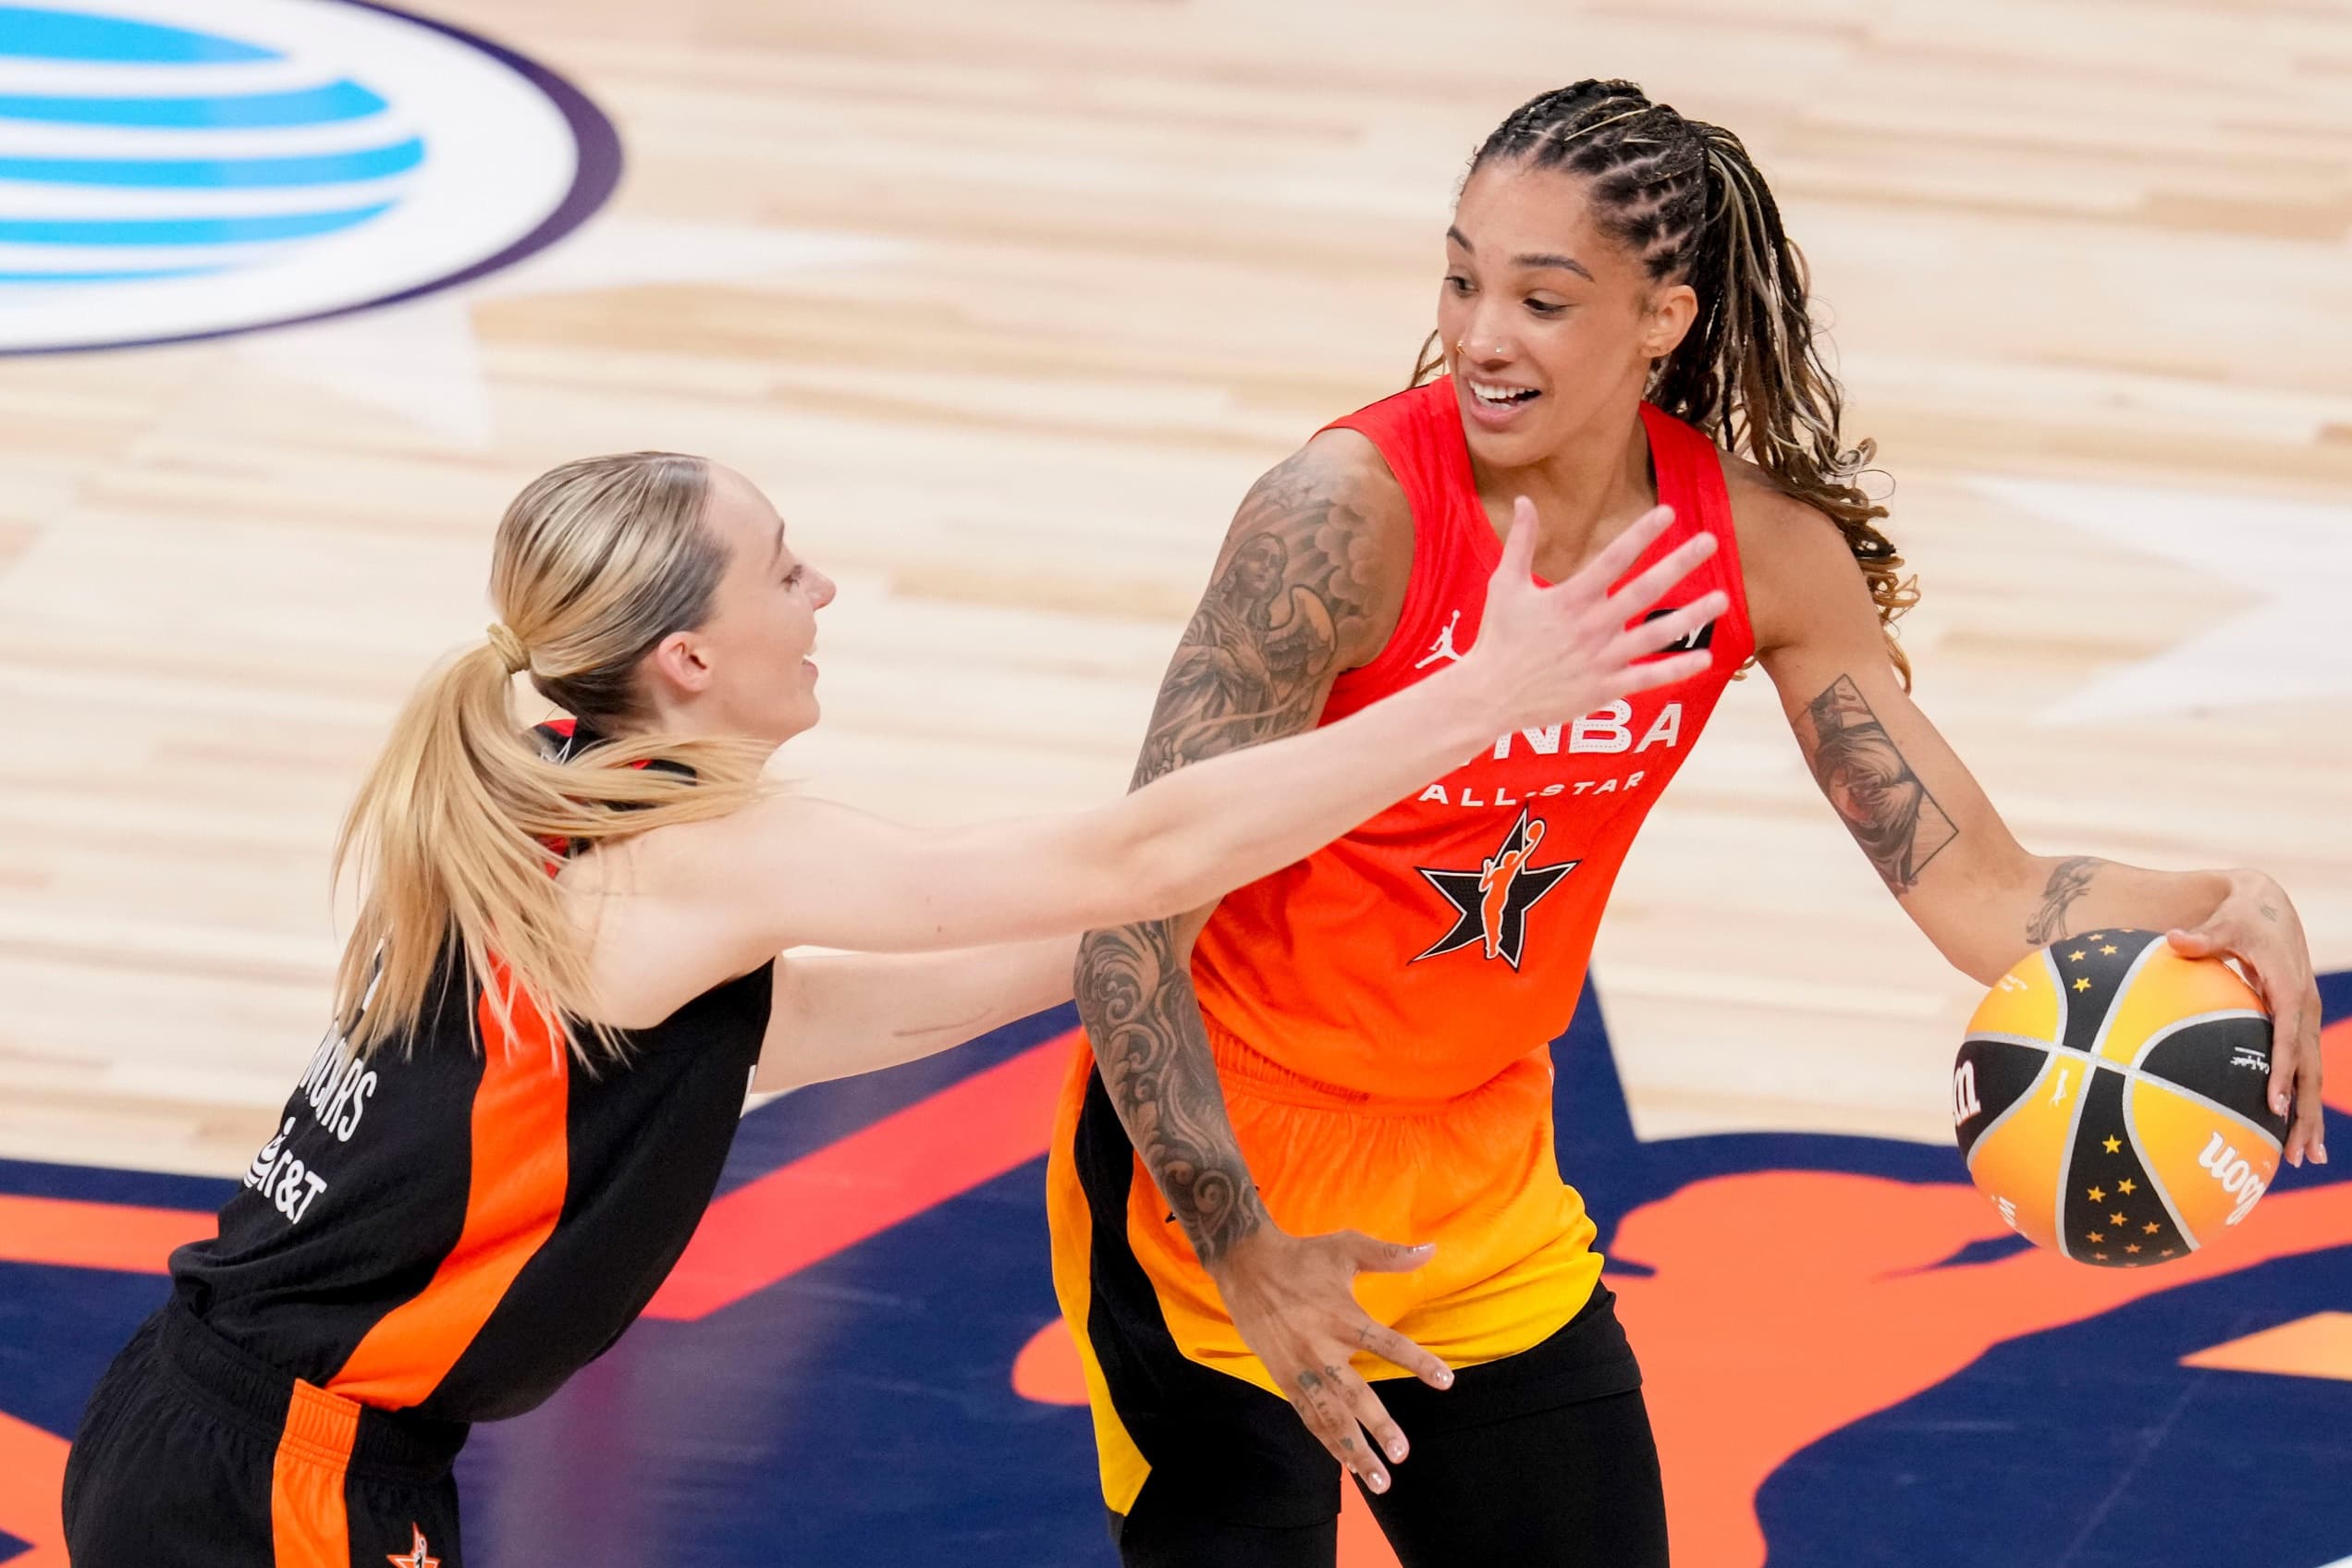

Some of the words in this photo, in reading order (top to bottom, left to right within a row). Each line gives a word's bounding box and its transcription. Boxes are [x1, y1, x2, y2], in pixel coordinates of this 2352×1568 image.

[1463, 699, 1683, 767] NBA
[1418, 771, 1645, 807] ALL-STAR
[2198, 1131, 2267, 1227] lson
